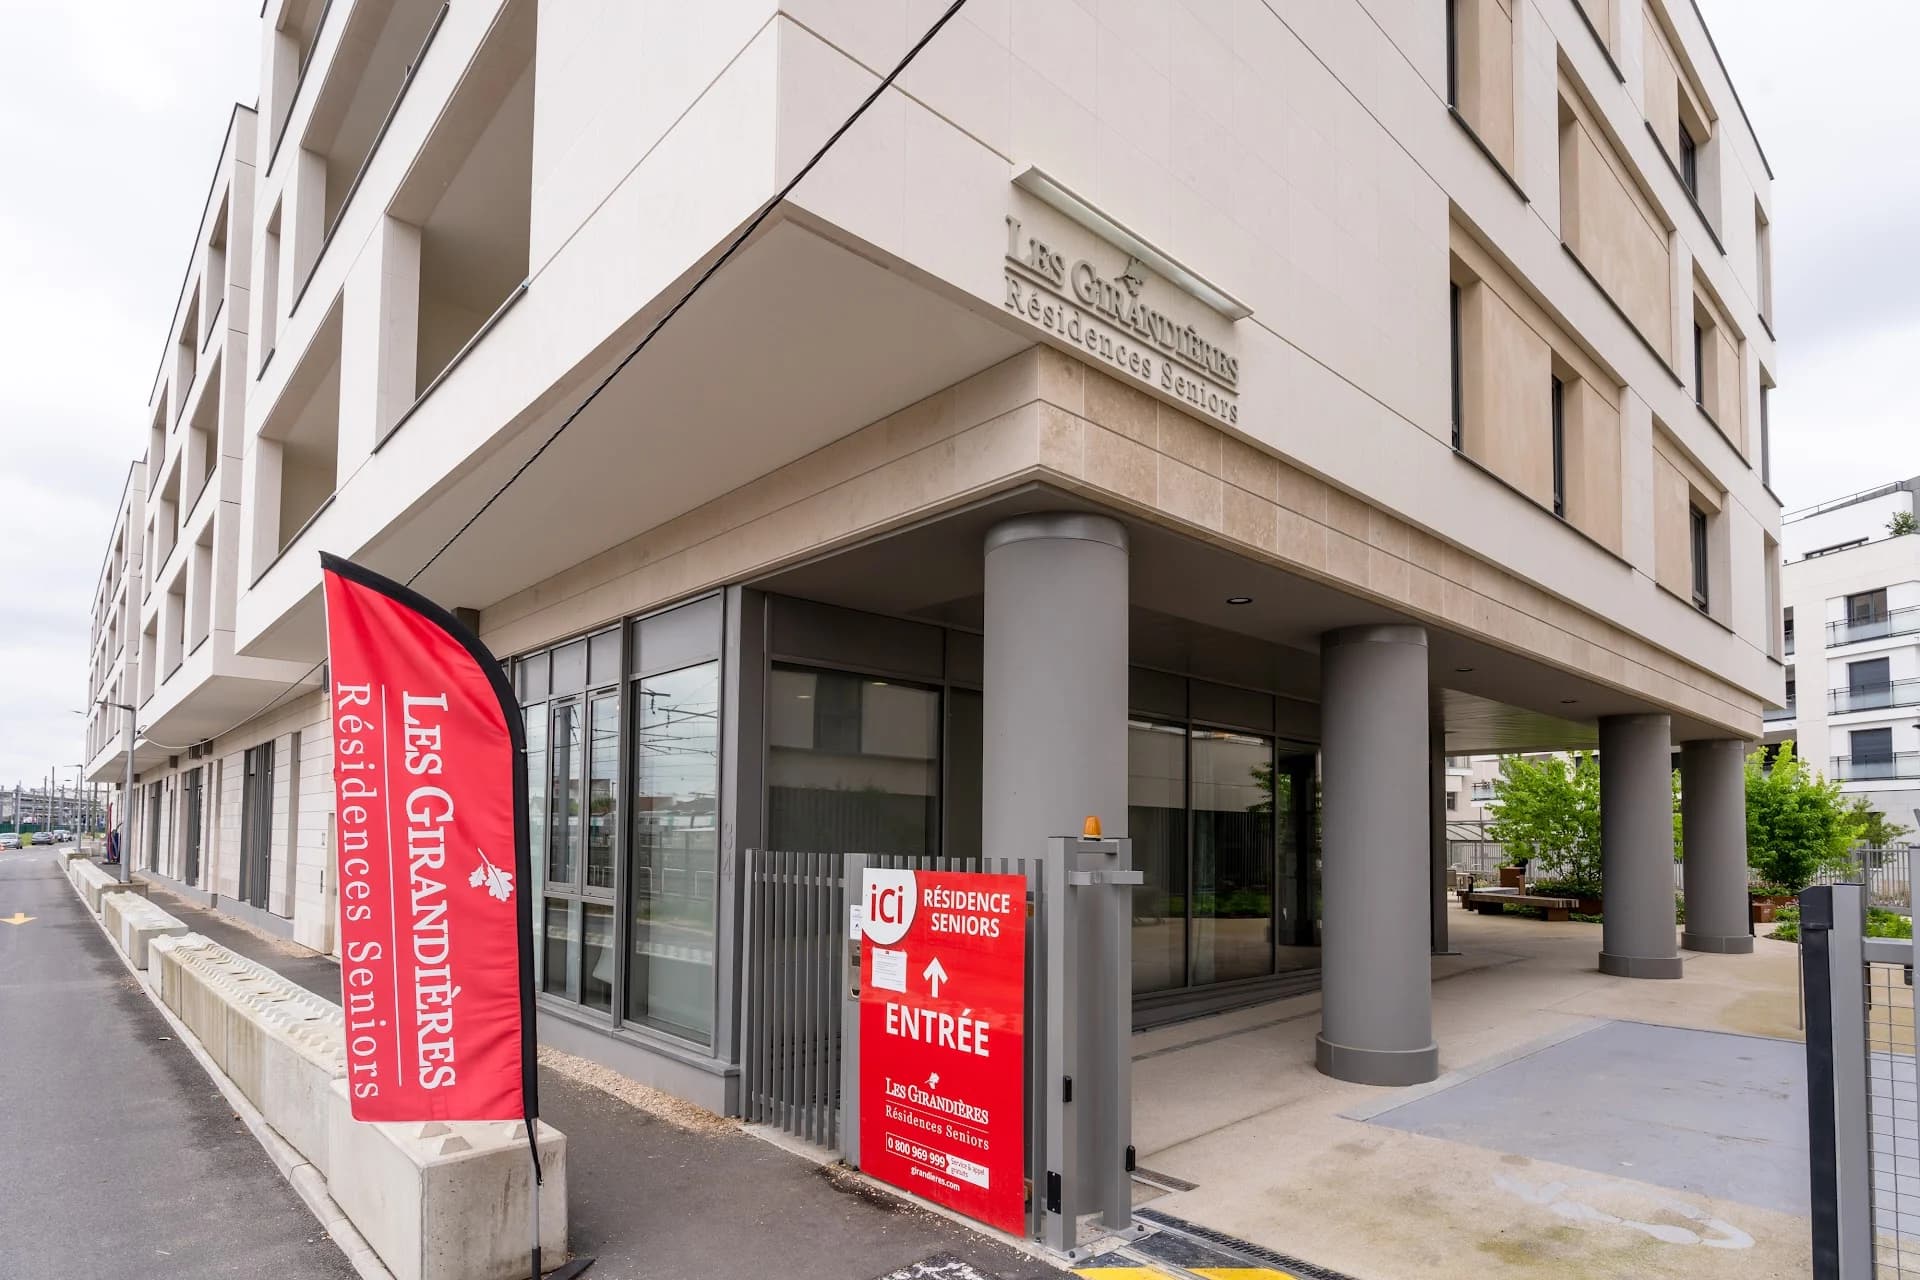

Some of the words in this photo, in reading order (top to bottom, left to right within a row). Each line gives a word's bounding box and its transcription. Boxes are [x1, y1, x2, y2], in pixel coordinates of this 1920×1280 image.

[1004, 214, 1065, 288] LES
[1071, 259, 1239, 387] GIRANDIÈRES
[1004, 275, 1151, 380] Résidences
[1160, 361, 1238, 424] Seniors
[402, 690, 449, 776] LES
[336, 682, 377, 922] Résidences
[923, 885, 1011, 914] RÉSIDENCE
[931, 912, 1000, 938] SENIORS
[406, 785, 461, 1089] GIRANDIÈRES
[347, 941, 388, 1099] Seniors
[886, 1001, 990, 1058] ENTRÉE
[885, 1077, 906, 1099] LES
[907, 1084, 989, 1125] GIRANDIÈRES
[885, 1104, 942, 1135] Résidences
[946, 1125, 990, 1151] Seniors
[887, 1137, 894, 1149] 0
[895, 1140, 911, 1155] 800
[912, 1145, 928, 1161] 969
[930, 1152, 946, 1168] 999
[911, 1165, 960, 1192] girandieres.com
